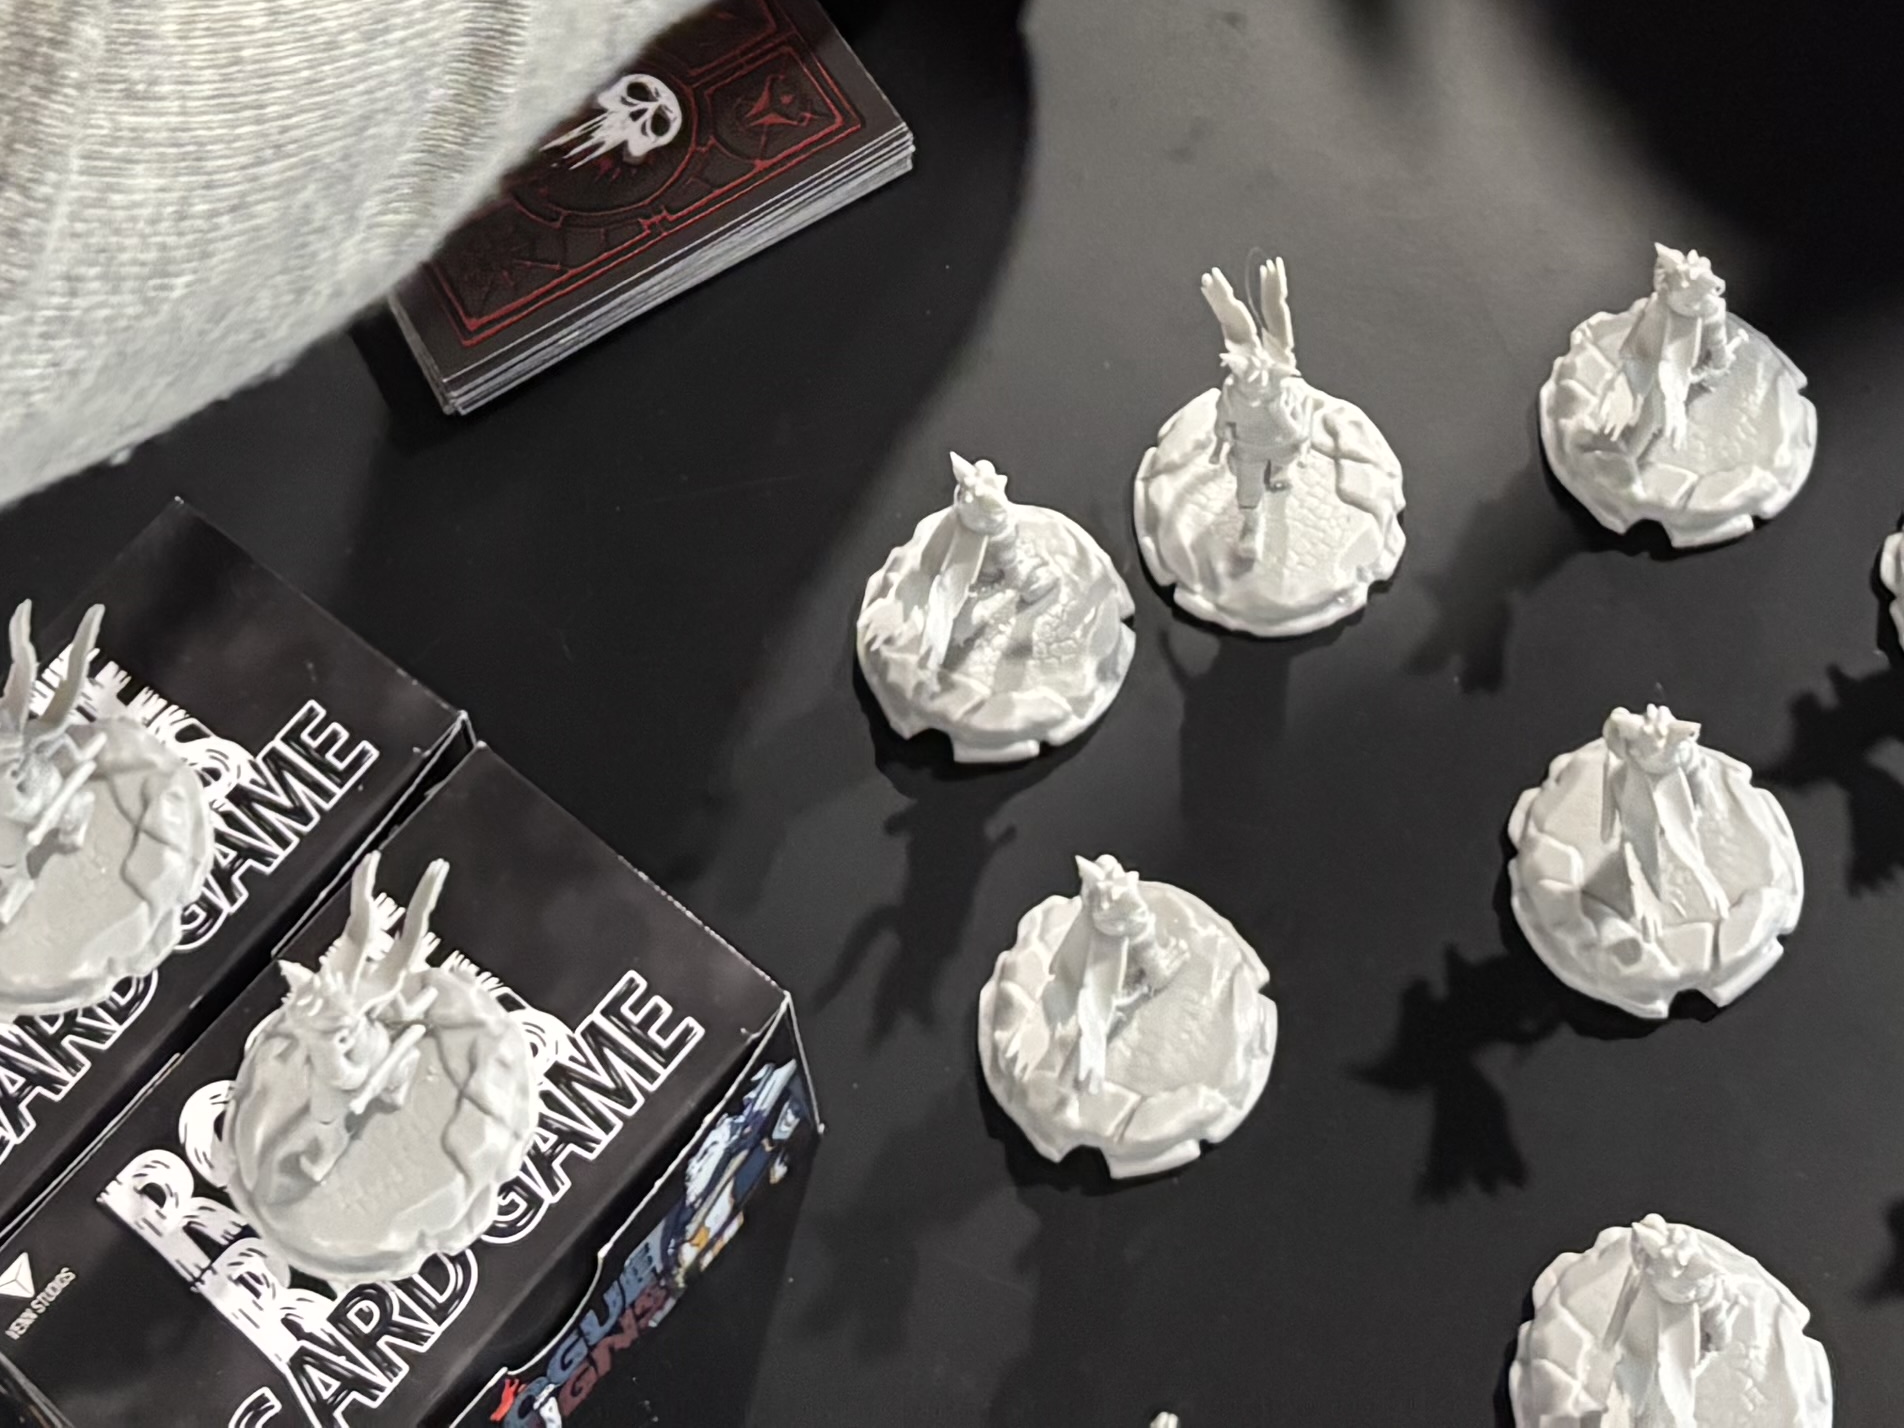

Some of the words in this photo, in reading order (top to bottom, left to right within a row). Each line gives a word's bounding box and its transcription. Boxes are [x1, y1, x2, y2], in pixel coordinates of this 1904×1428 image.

[171, 698, 380, 953] GAME
[228, 1246, 479, 1428] ARD
[480, 970, 706, 1243] GAME
[501, 1220, 668, 1428] OGUE
